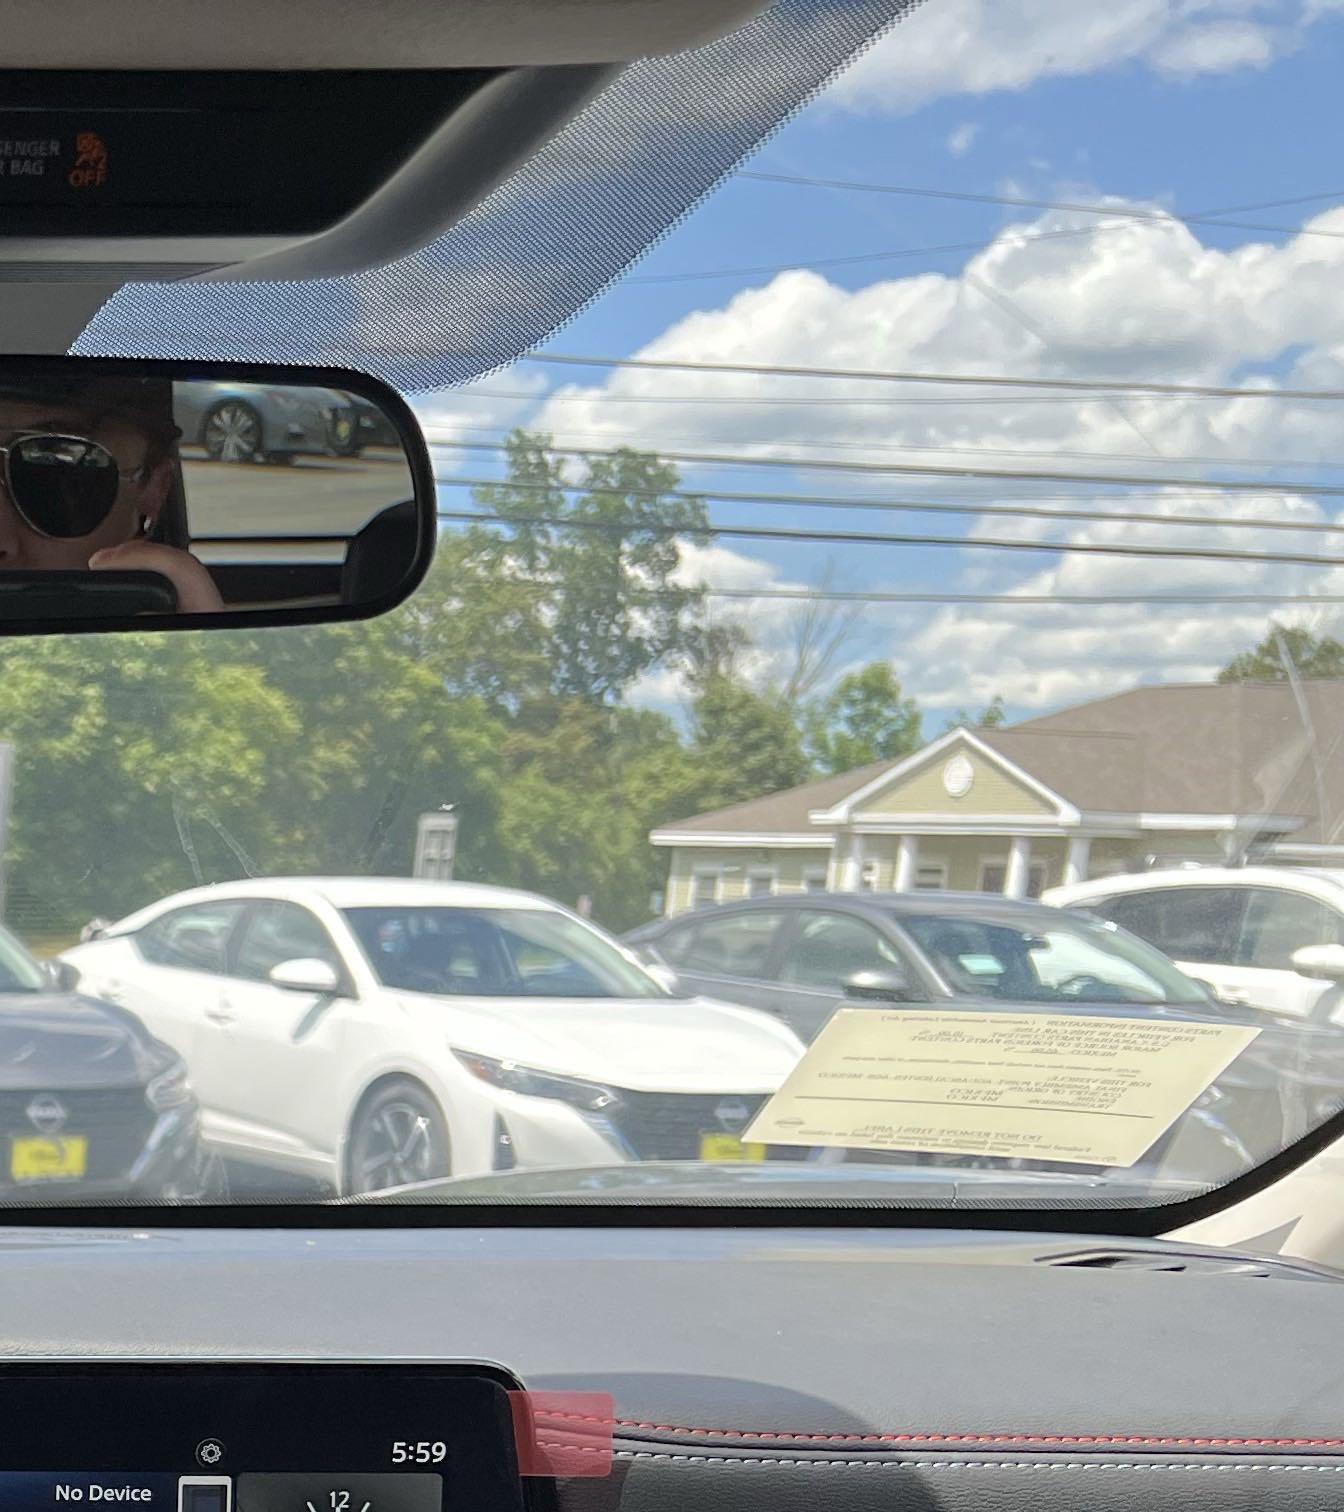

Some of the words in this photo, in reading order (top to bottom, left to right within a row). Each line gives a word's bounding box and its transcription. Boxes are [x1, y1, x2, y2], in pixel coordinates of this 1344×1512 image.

[10, 159, 45, 176] BAG
[69, 170, 106, 187] OFF
[391, 1441, 447, 1464] 5:59
[55, 1485, 83, 1502] No
[89, 1485, 152, 1502] Device
[329, 1491, 351, 1509] 12
